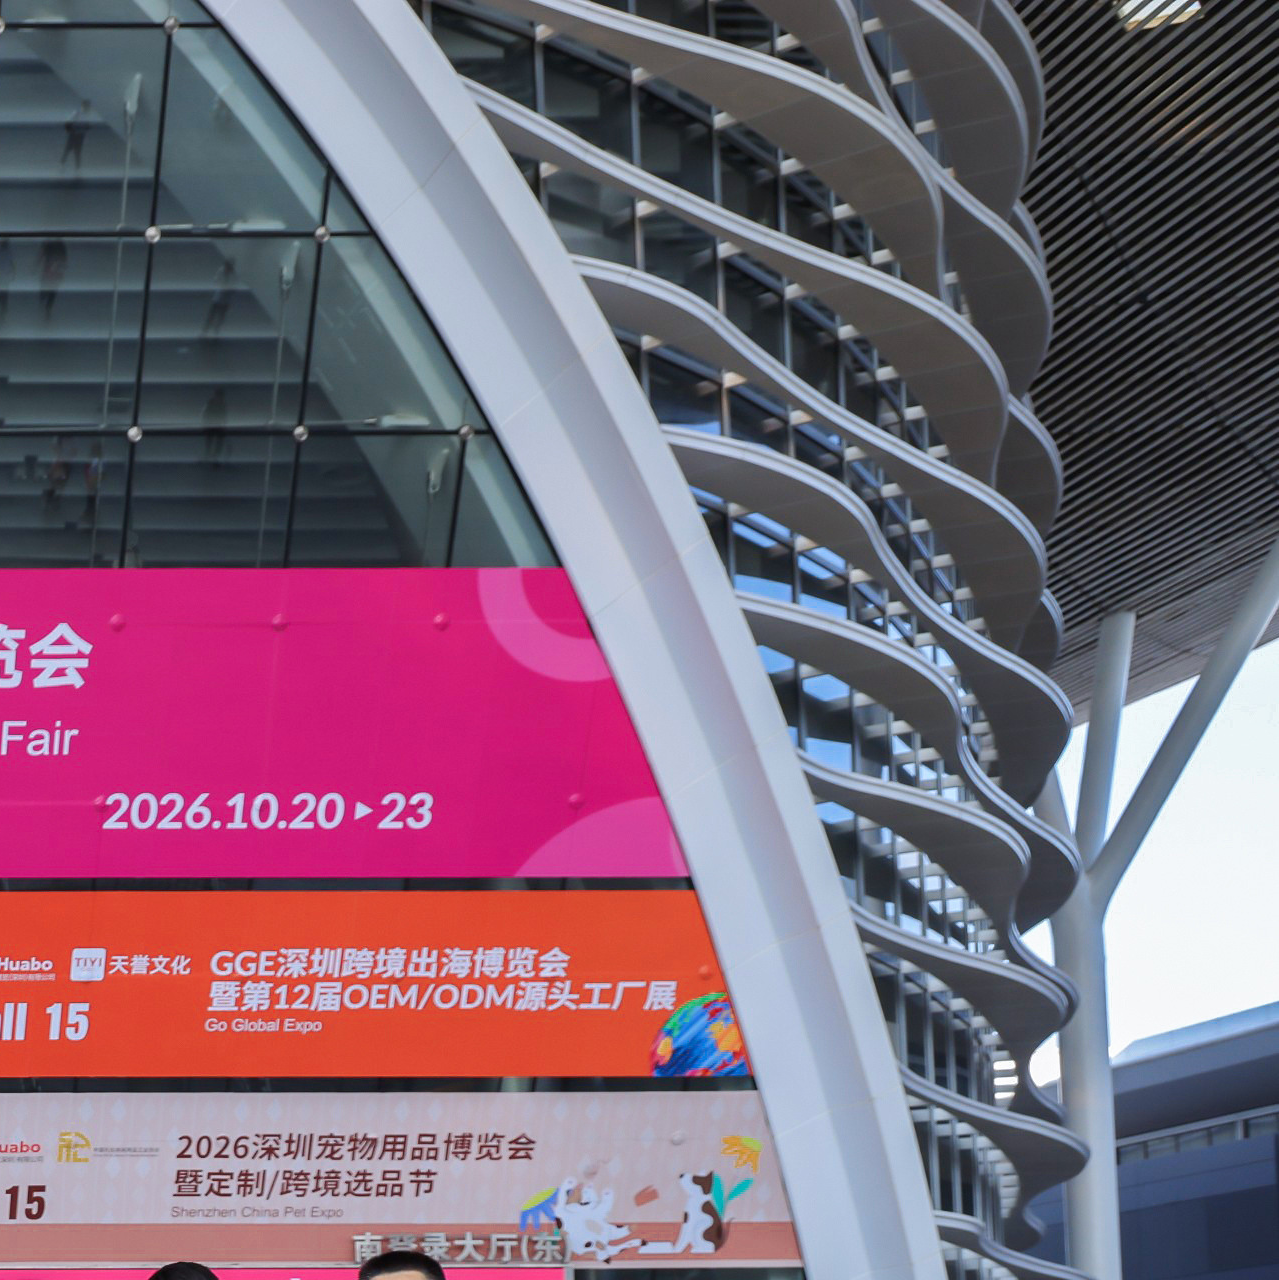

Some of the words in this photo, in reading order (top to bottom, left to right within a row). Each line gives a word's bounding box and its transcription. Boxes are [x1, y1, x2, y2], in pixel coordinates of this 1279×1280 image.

[0, 721, 78, 757] Fair
[102, 792, 345, 829] 2026.10.20
[377, 792, 434, 829] 23
[108, 955, 191, 976] 天誉文化
[210, 948, 571, 979] GGE深圳跨境出海博览会
[207, 980, 677, 1012] 暨第12届OEM/ODM源头工厂展
[46, 1002, 90, 1041] 15
[204, 1018, 227, 1032] Go
[232, 1018, 279, 1032] Global
[284, 1018, 322, 1034] Expo
[176, 1132, 537, 1162] 2026深圳宠物用品博览会
[172, 1169, 440, 1200] 暨定制/跨境选品节
[5, 1185, 46, 1220] 15
[171, 1206, 237, 1218] Shenzhen
[241, 1206, 279, 1218] China
[284, 1206, 306, 1218] Pet
[311, 1206, 344, 1220] Expo
